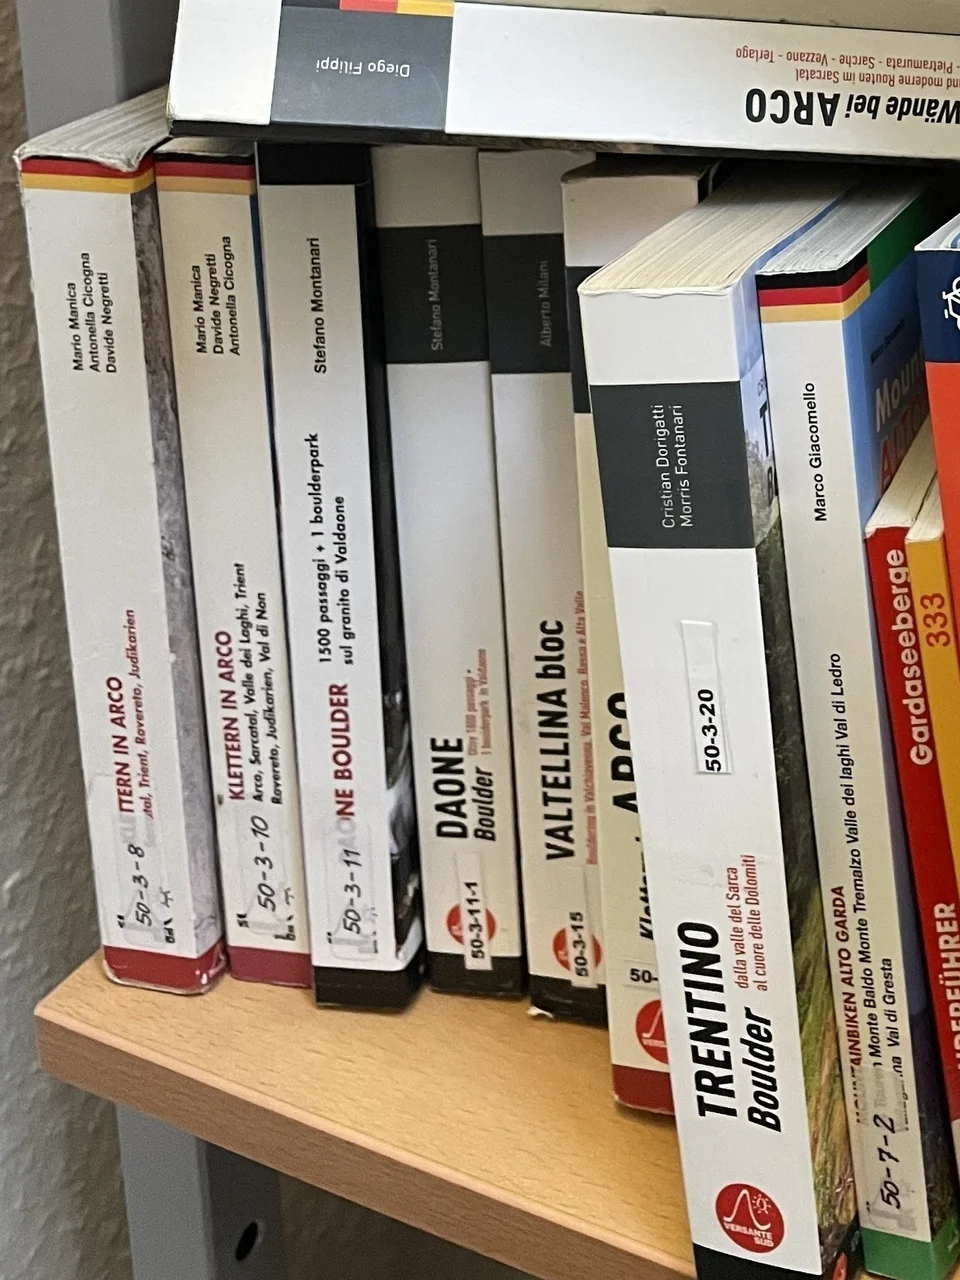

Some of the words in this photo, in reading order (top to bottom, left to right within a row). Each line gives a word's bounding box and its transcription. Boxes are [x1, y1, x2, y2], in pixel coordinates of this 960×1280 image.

[315, 57, 363, 75] Filippi
[367, 59, 411, 78] Diego
[744, 89, 840, 127] ARCO
[844, 93, 881, 120] bei
[79, 252, 96, 307] Cicogna
[189, 264, 203, 313] Manica
[205, 253, 222, 306] Negretti
[220, 236, 237, 291] Cicogna
[306, 237, 324, 313] Montanari
[426, 239, 441, 301] Montanari
[66, 282, 79, 329] Manica
[98, 271, 115, 325] Negretti
[84, 311, 100, 373] Antonella
[102, 329, 117, 373] Davide
[193, 316, 208, 354] Mario
[210, 310, 224, 355] Davide
[224, 294, 241, 356] Antonella
[311, 317, 327, 374] Stefano
[429, 304, 444, 351] Stefano
[70, 334, 84, 371] Mario
[651, 404, 671, 467] Dorigatti
[670, 404, 689, 475] Fontanari
[802, 382, 824, 469] Giacomello
[654, 472, 676, 528] Cristian
[672, 480, 693, 527] Morris
[810, 473, 827, 522] Marco
[919, 593, 951, 648] 333
[215, 631, 235, 683] ARCO
[535, 619, 565, 680] bloc
[828, 653, 845, 696] Ledro
[884, 549, 935, 765] Gardaseeberge
[106, 677, 127, 730] ARCO
[221, 689, 238, 711] IN
[830, 700, 846, 713] di
[112, 734, 130, 756] IN
[328, 683, 353, 780] BOULDER
[697, 689, 721, 773] 50-3-20
[832, 717, 849, 740] Val
[222, 717, 246, 801] KLETTERN
[536, 688, 575, 861] VALTELLINA
[834, 744, 854, 780] laghi
[429, 736, 468, 839] DAONE
[473, 767, 496, 842] Boulder
[840, 784, 856, 805] dei
[844, 809, 860, 844] Valle
[126, 843, 152, 928] 50-3-8
[250, 815, 277, 912] 50-3-10
[724, 866, 741, 902] Sarca
[848, 848, 868, 913] Tremalzo
[342, 848, 363, 935] 50-3-11
[728, 904, 745, 923] del
[831, 886, 849, 943] GARDA
[464, 881, 485, 959] 50-3-11-1
[569, 911, 589, 978] 50-3-15
[731, 926, 747, 957] valle
[855, 917, 873, 964] Monte
[733, 959, 750, 990] dalla
[838, 948, 855, 987] ALTO
[858, 968, 878, 1008] Baldo
[880, 958, 896, 1005] Gresta
[676, 921, 738, 1119] TRENTINO
[865, 1011, 884, 1058] Monte
[884, 1010, 897, 1022] di
[884, 1027, 900, 1047] Val
[739, 1006, 782, 1133] Boulder
[872, 1113, 901, 1210] 50-7-2
